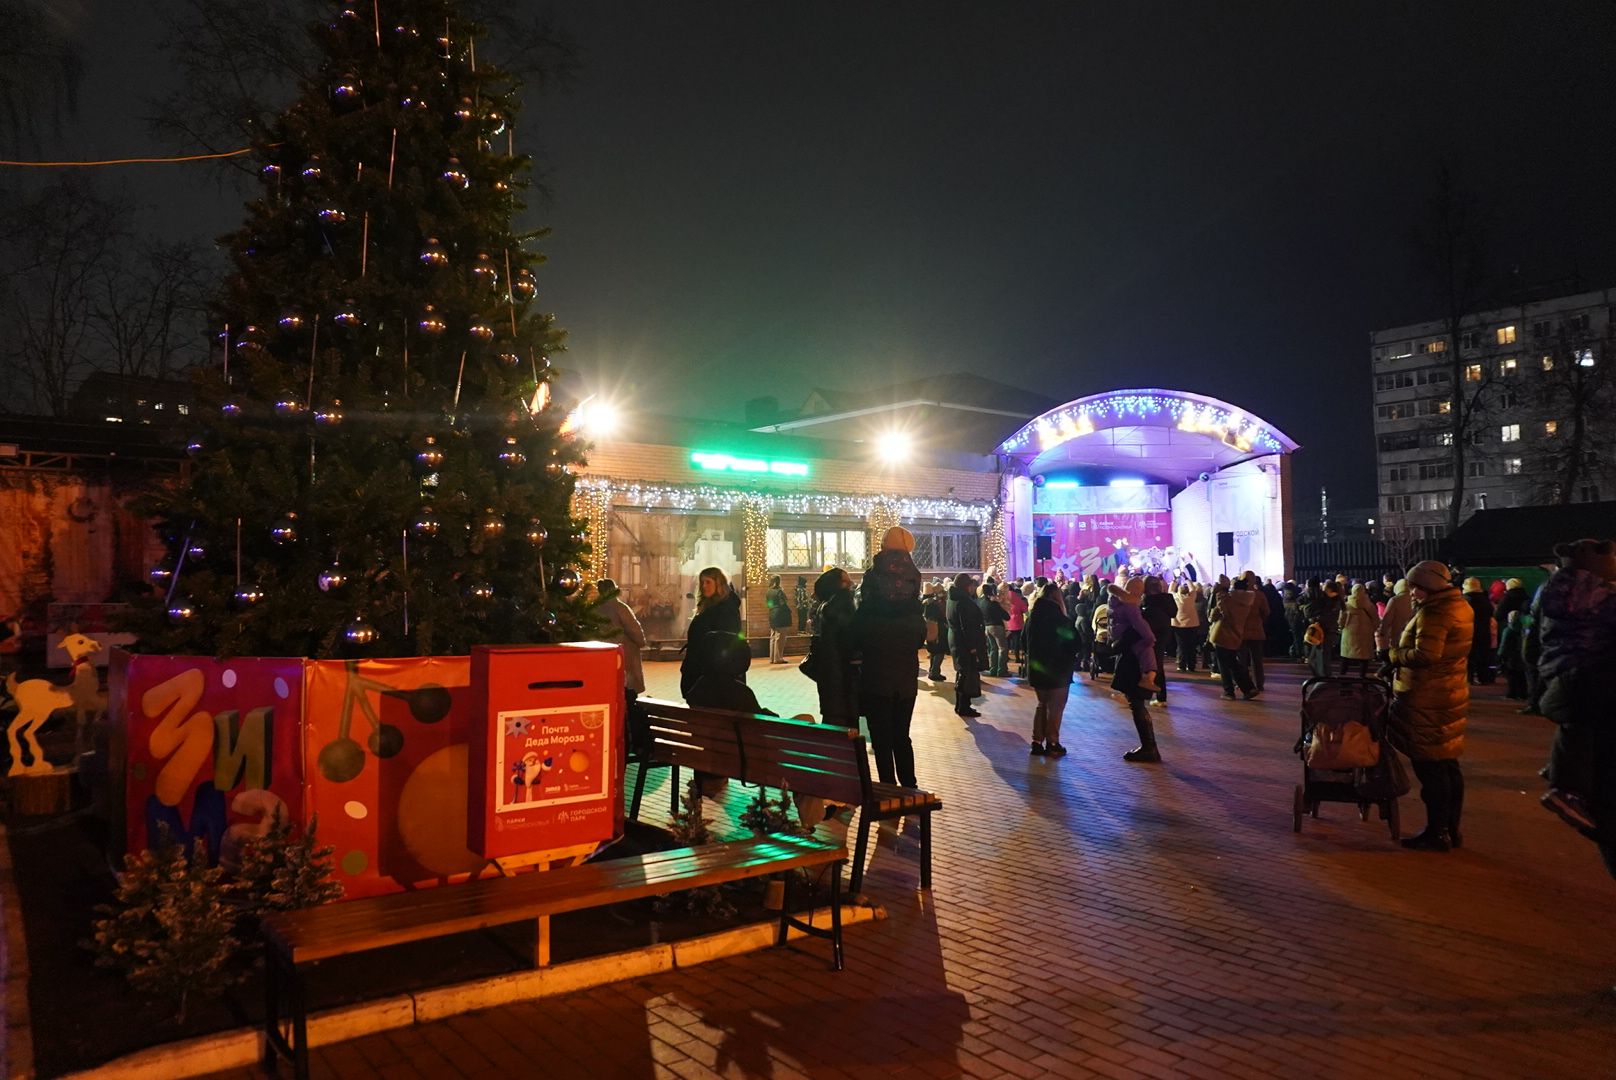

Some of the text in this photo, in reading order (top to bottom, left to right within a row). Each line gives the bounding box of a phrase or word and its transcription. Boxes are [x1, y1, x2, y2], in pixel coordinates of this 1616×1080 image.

[541, 725, 570, 735] Почта
[525, 734, 585, 747] Деда Мороза
[570, 806, 607, 816] ГОРОДСКОЙ
[570, 815, 586, 823] ПАРК
